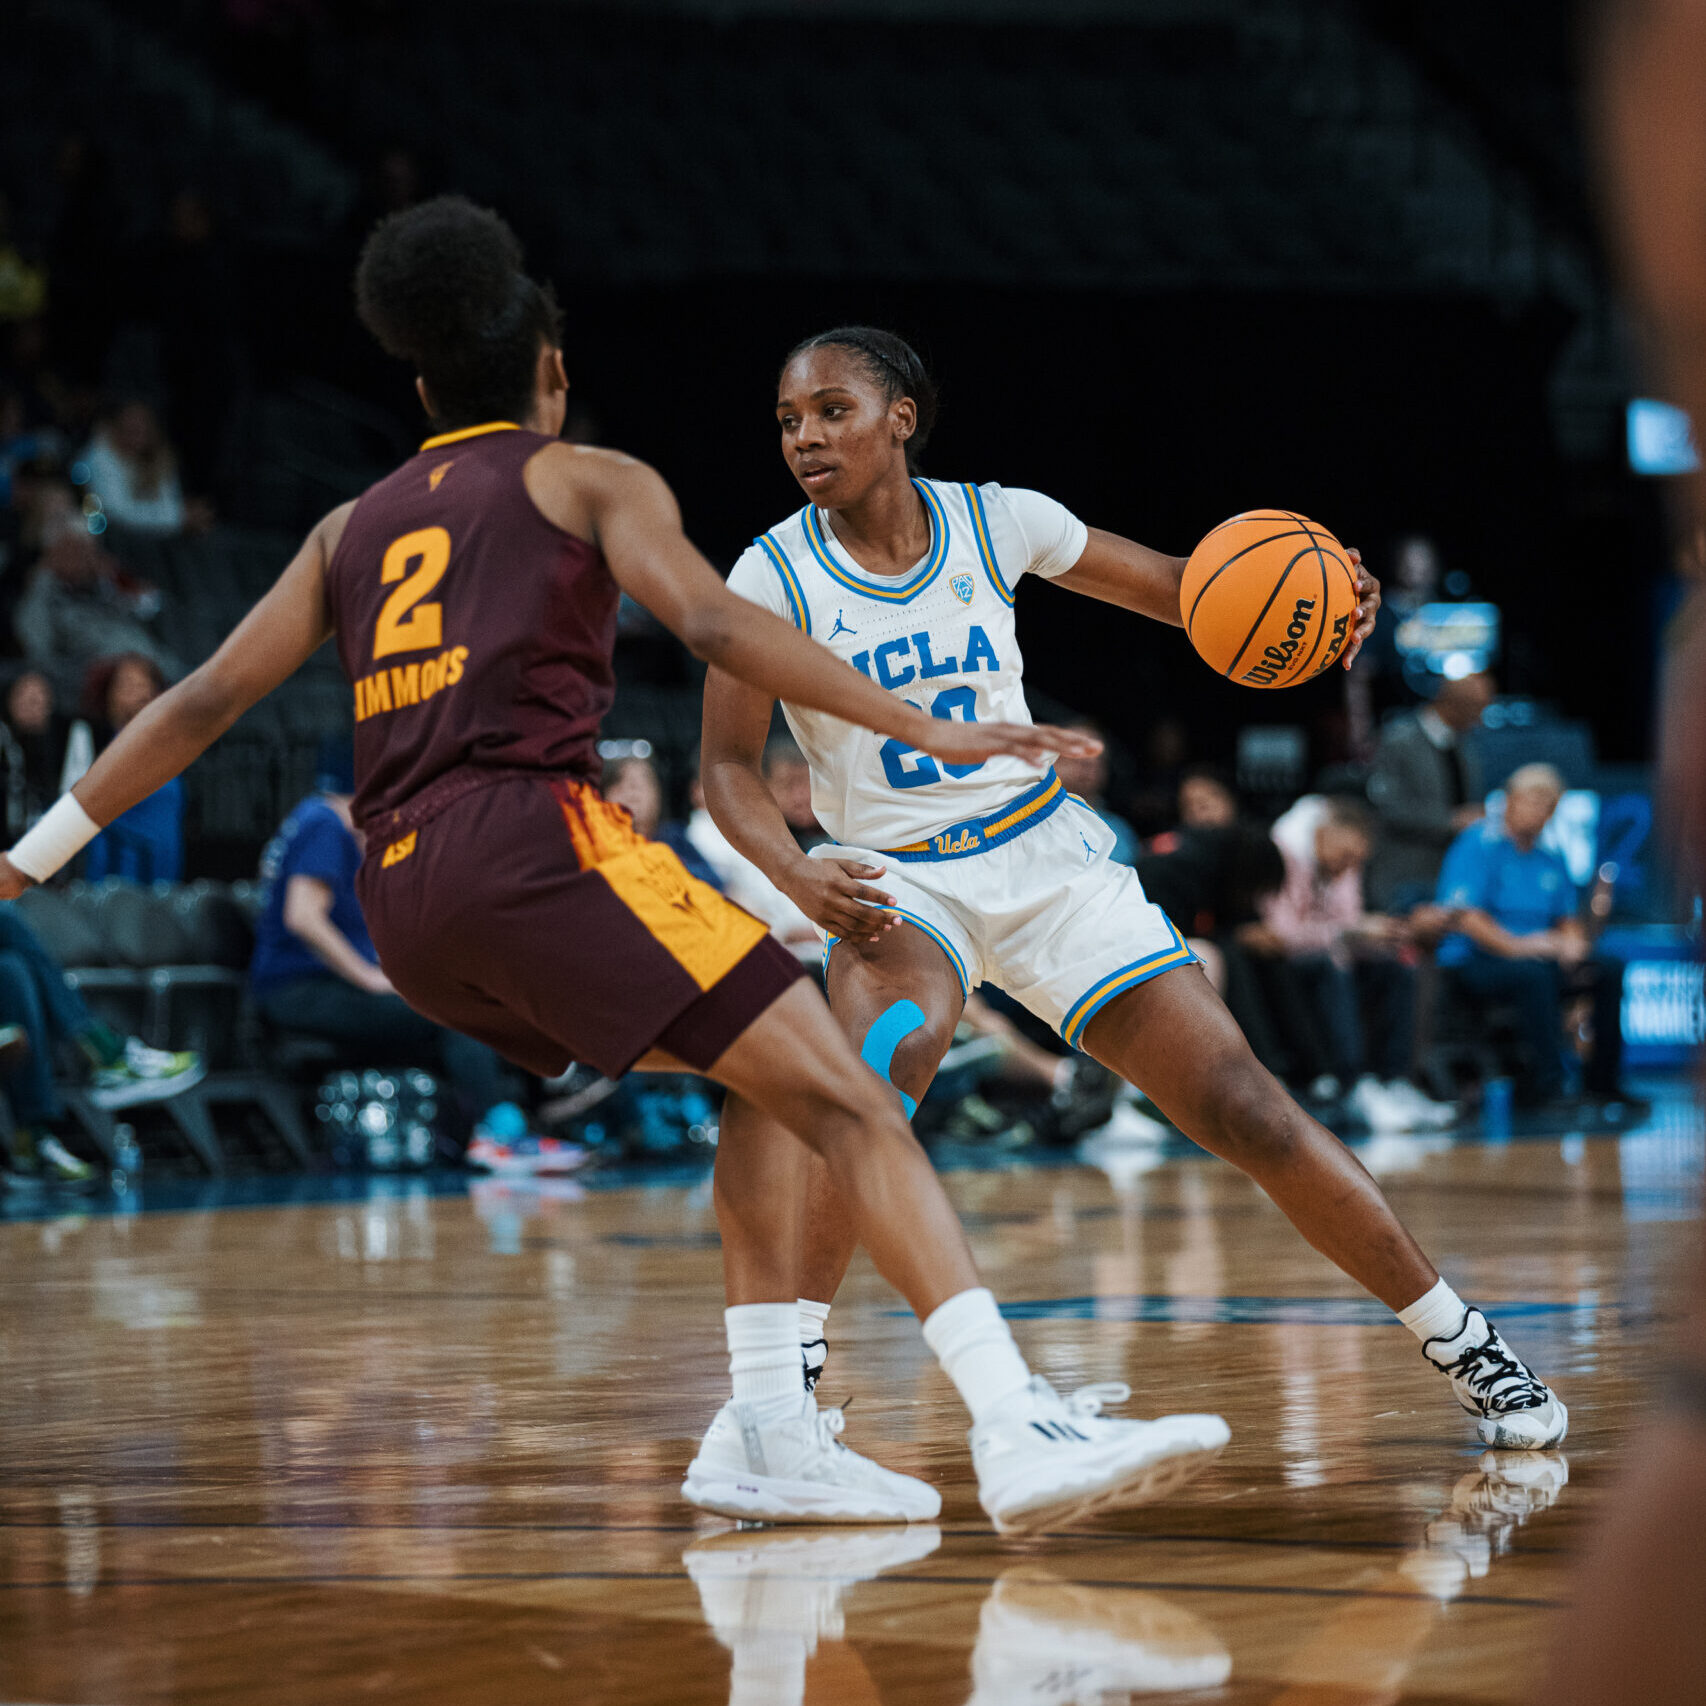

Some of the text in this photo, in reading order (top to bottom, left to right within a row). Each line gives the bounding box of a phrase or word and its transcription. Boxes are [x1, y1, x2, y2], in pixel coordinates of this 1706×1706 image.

[373, 526, 451, 661] 2
[1241, 597, 1316, 685] Wilson
[1303, 613, 1350, 681] CAA
[934, 828, 981, 855] Ucla
